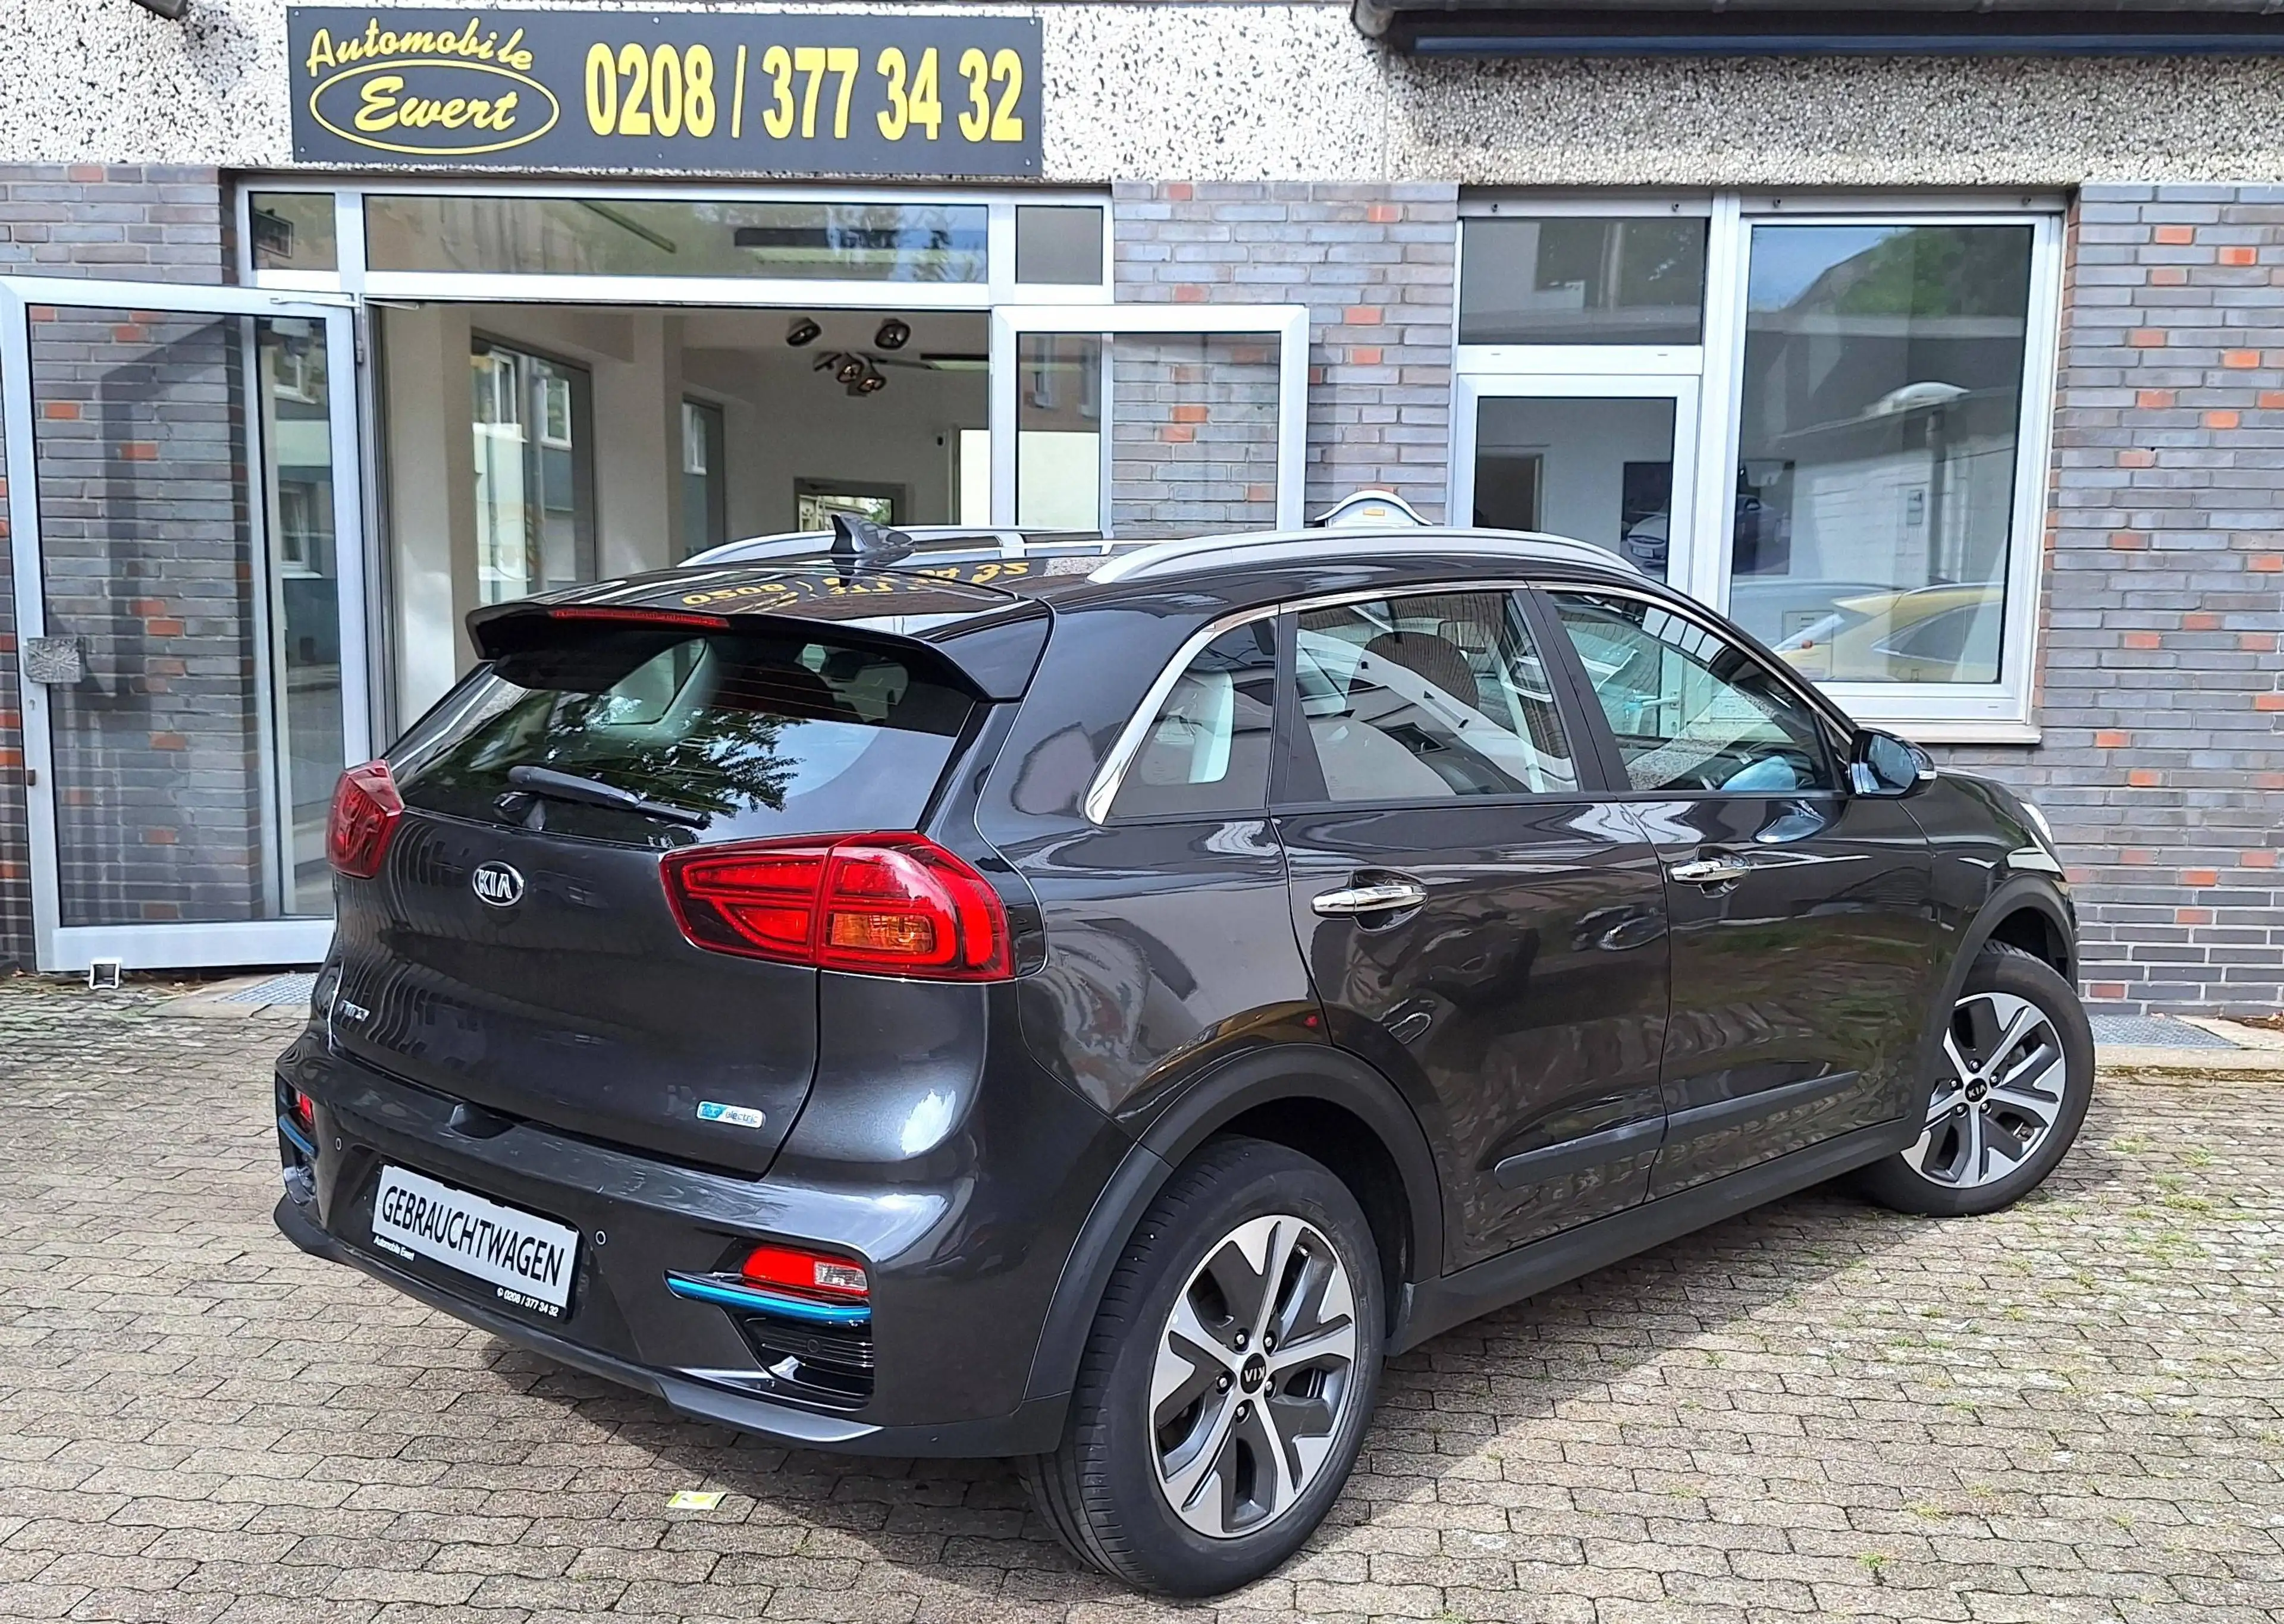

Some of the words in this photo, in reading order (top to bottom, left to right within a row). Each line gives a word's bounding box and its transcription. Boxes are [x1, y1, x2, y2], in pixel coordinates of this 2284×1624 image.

[306, 17, 534, 77] Automobile
[354, 76, 518, 131] Ewert
[585, 42, 715, 137] 0208
[731, 45, 746, 138] /
[762, 45, 859, 139] 377
[876, 47, 942, 140] 34
[958, 48, 1023, 142] 32
[477, 869, 513, 899] KIA
[1968, 1084, 1987, 1098] KIA
[382, 1185, 565, 1286] GEBRAUCHTWAGEN
[1244, 1365, 1265, 1383] KIA
